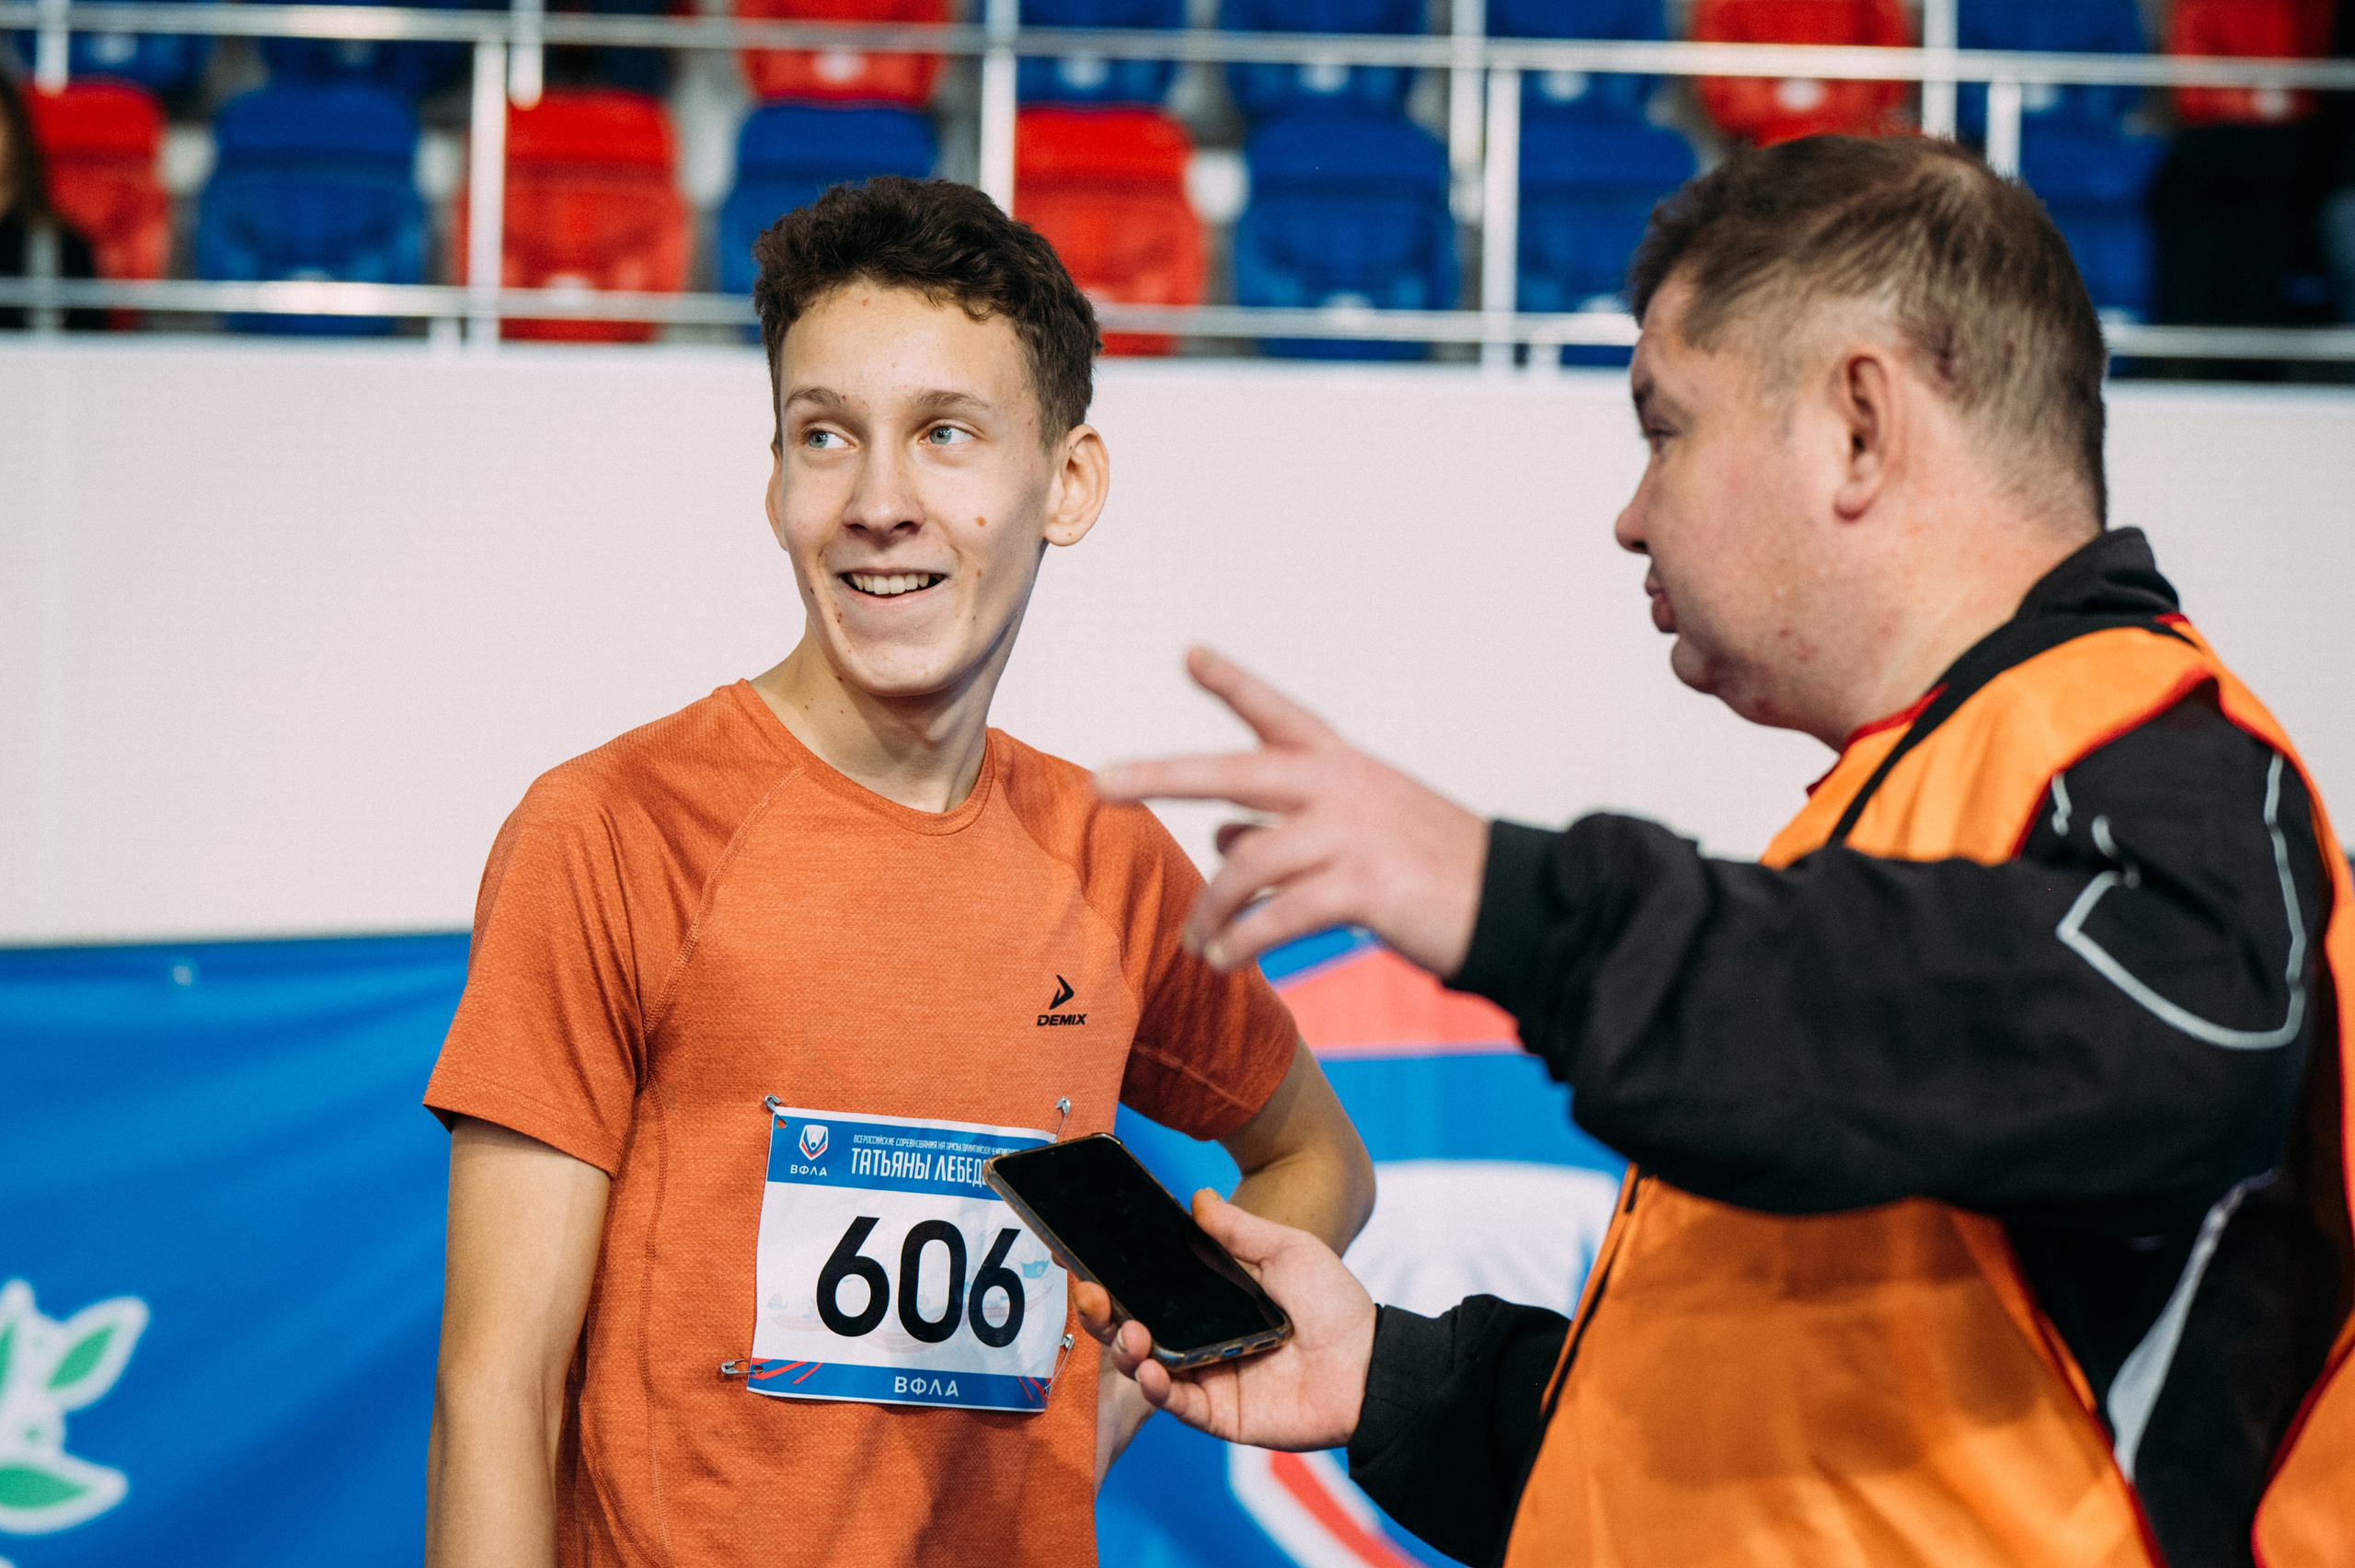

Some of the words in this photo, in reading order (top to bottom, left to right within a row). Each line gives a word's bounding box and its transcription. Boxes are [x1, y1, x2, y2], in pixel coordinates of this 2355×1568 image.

[1037, 1013, 1087, 1026] DEMIX
[854, 1134, 895, 1146] ВСЕРОССИЙСКИЕ
[896, 1138, 937, 1150] СОРЕВНОВАНИЯ
[938, 1141, 946, 1150] НА
[790, 1164, 828, 1176] ВФЛА
[851, 1148, 931, 1180] ТАТЬЯНЫ
[935, 1154, 987, 1187] ЛЕБЕД
[816, 1216, 1025, 1348] 606
[894, 1376, 959, 1397] ВФЛА
